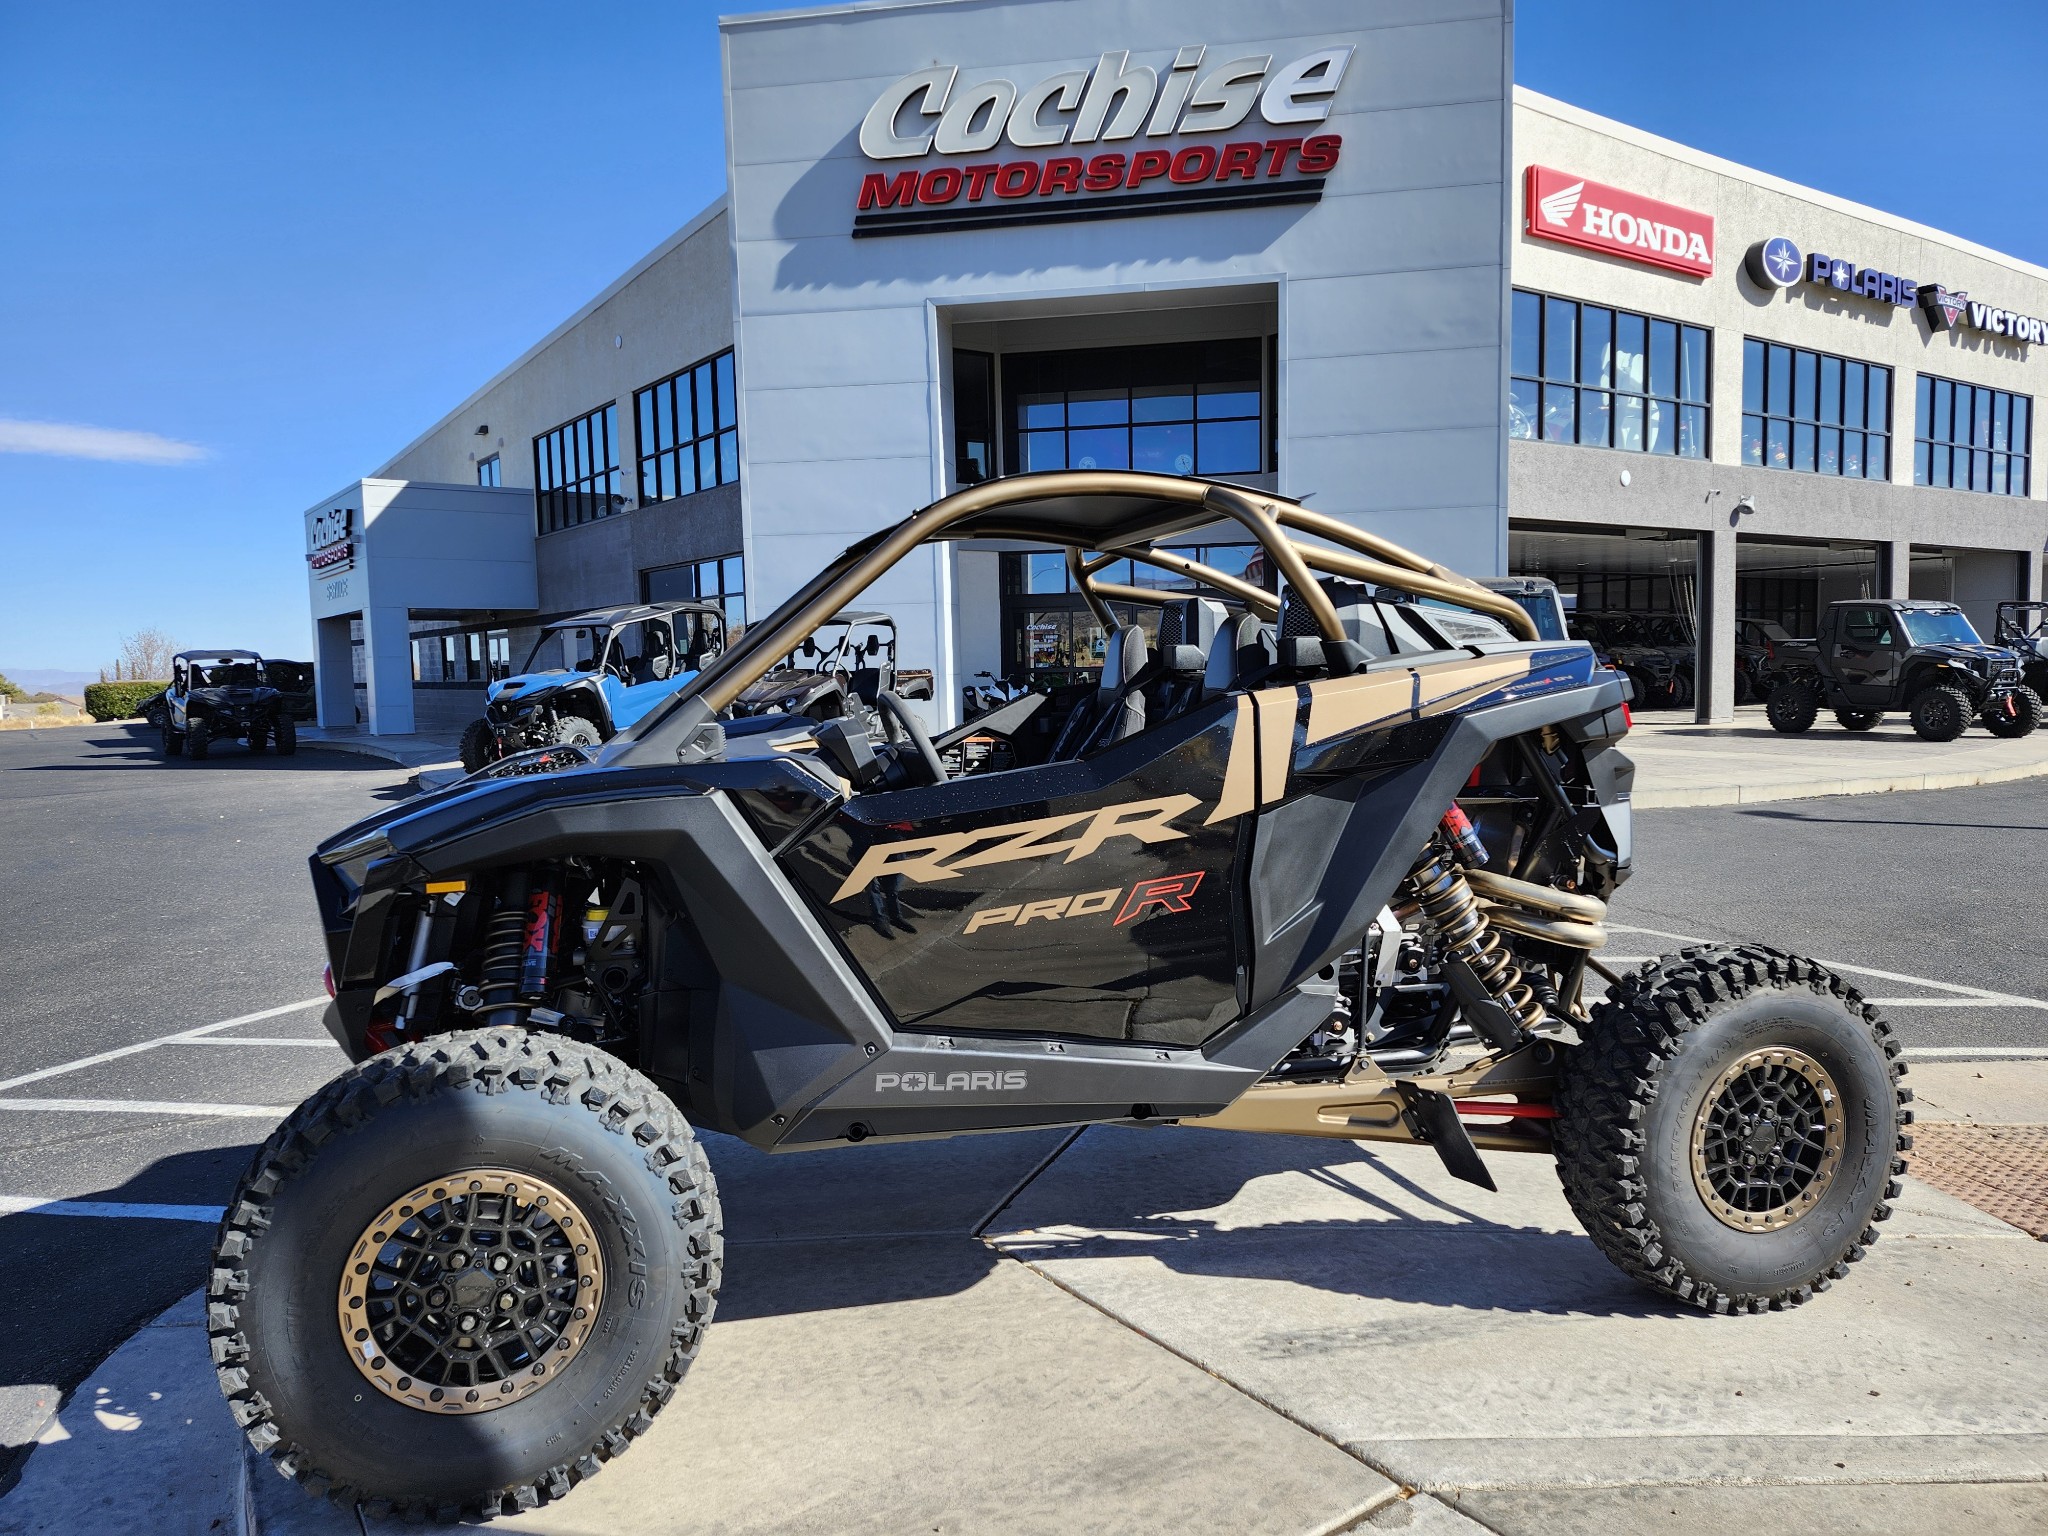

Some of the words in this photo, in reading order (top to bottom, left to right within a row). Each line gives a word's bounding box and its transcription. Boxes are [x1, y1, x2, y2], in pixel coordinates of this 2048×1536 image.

[859, 43, 1357, 159] Cochise
[856, 133, 1344, 210] MOTORSPORTS
[1582, 201, 1713, 264] HONDA
[1808, 252, 1918, 309] POLARIS
[1937, 294, 1967, 310] VICTORY
[1026, 623, 1058, 631] Cochise
[830, 793, 1203, 904] RZR
[962, 887, 1123, 935] PRO
[1112, 871, 1206, 926] R
[875, 1069, 1029, 1093] POLARIS
[539, 1146, 648, 1310] MAXXIS
